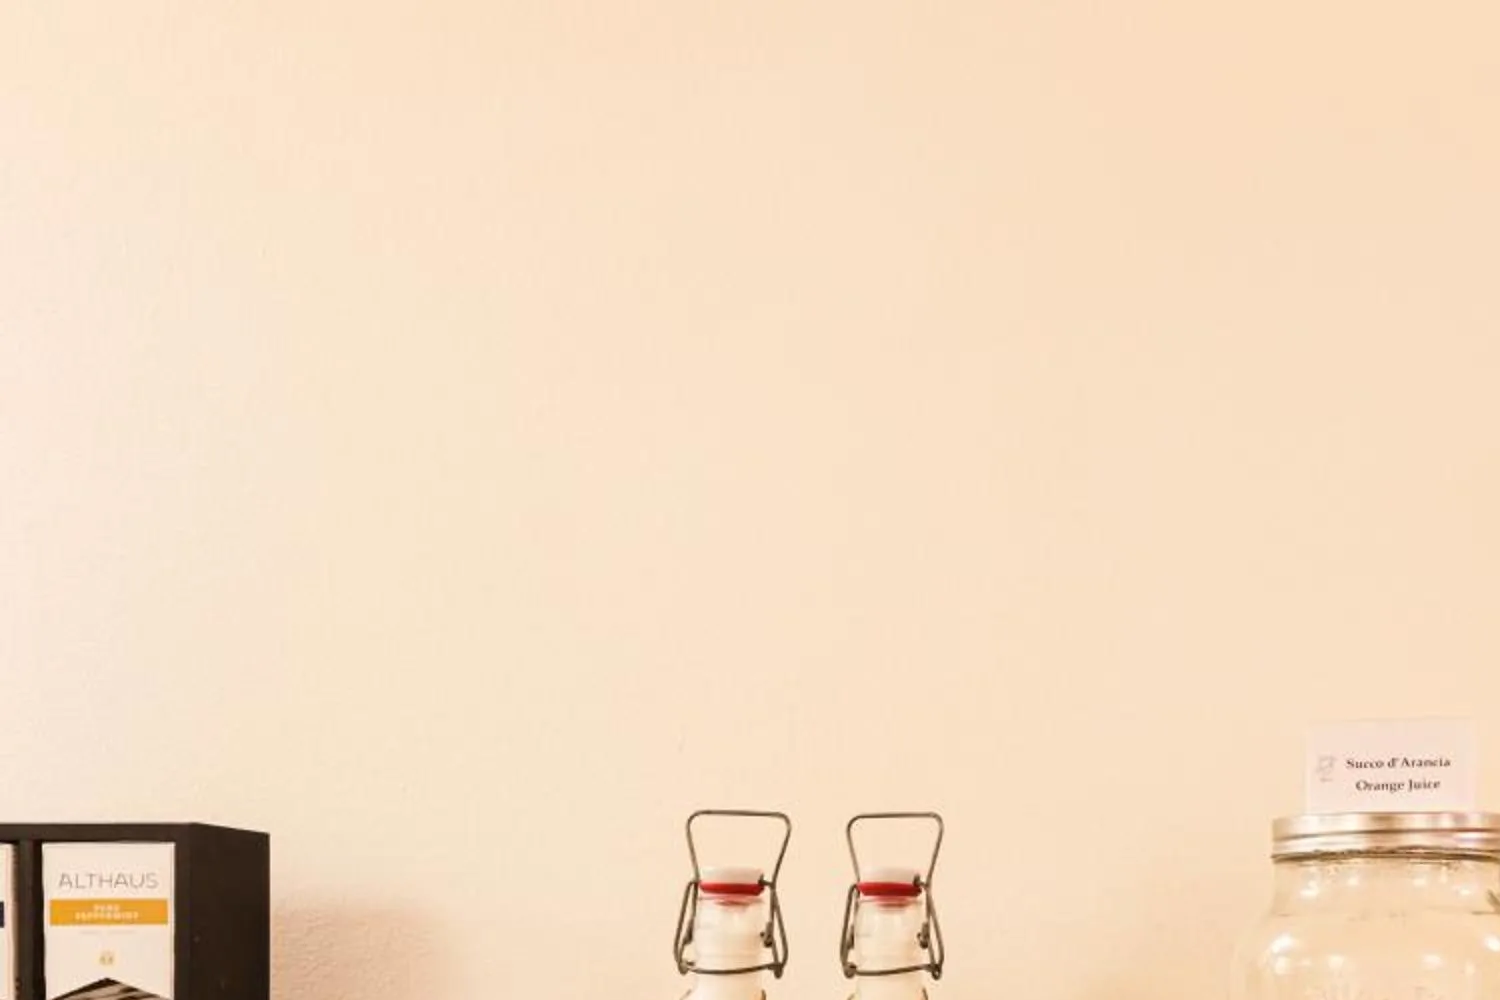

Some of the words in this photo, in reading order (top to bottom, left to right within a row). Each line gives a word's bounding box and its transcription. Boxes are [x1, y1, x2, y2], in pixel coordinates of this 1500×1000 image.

[1346, 757, 1384, 769] Succo
[1387, 756, 1451, 769] d'Arancia
[1355, 779, 1405, 793] Orange
[1408, 779, 1441, 792] Juice
[58, 872, 160, 889] ALTHAUS
